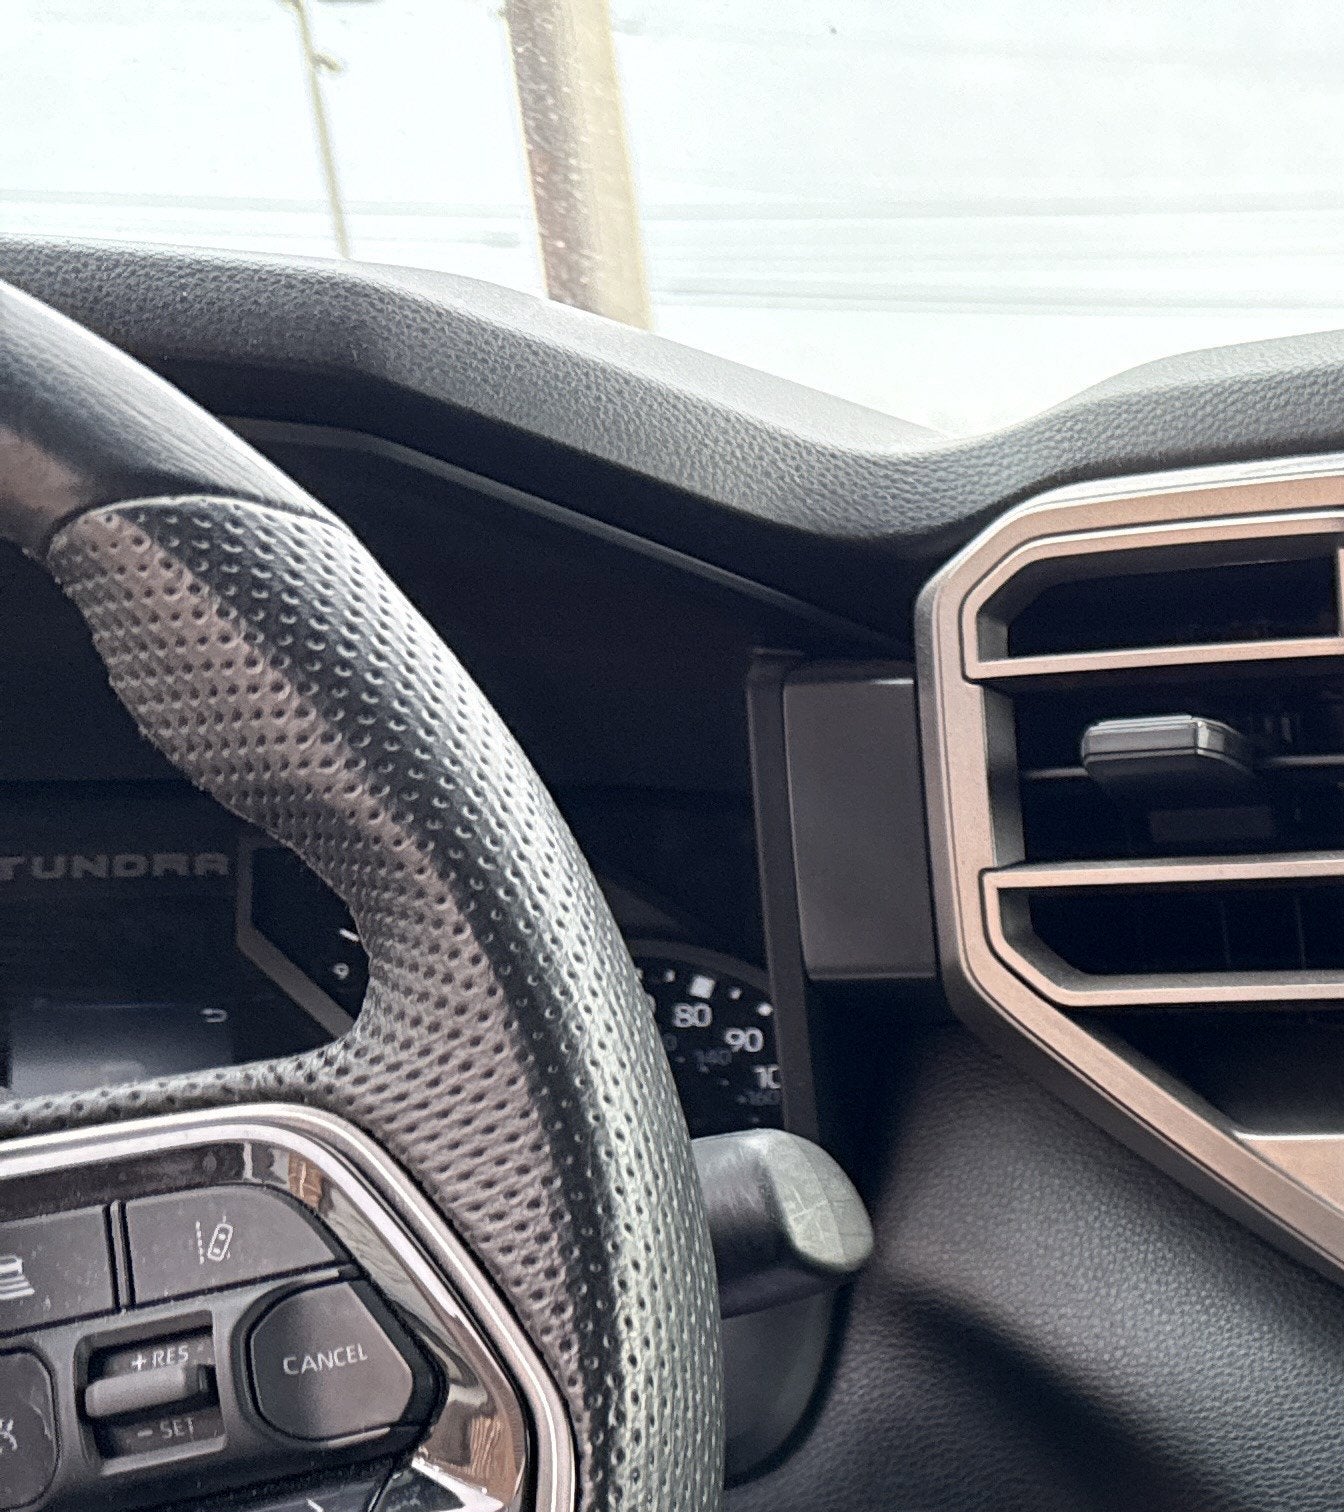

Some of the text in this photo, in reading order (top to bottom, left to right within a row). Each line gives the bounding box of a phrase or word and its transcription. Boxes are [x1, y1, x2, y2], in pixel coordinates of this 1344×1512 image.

[672, 1002, 713, 1029] 80
[723, 1026, 764, 1054] 90
[282, 1343, 369, 1376] CANCEL
